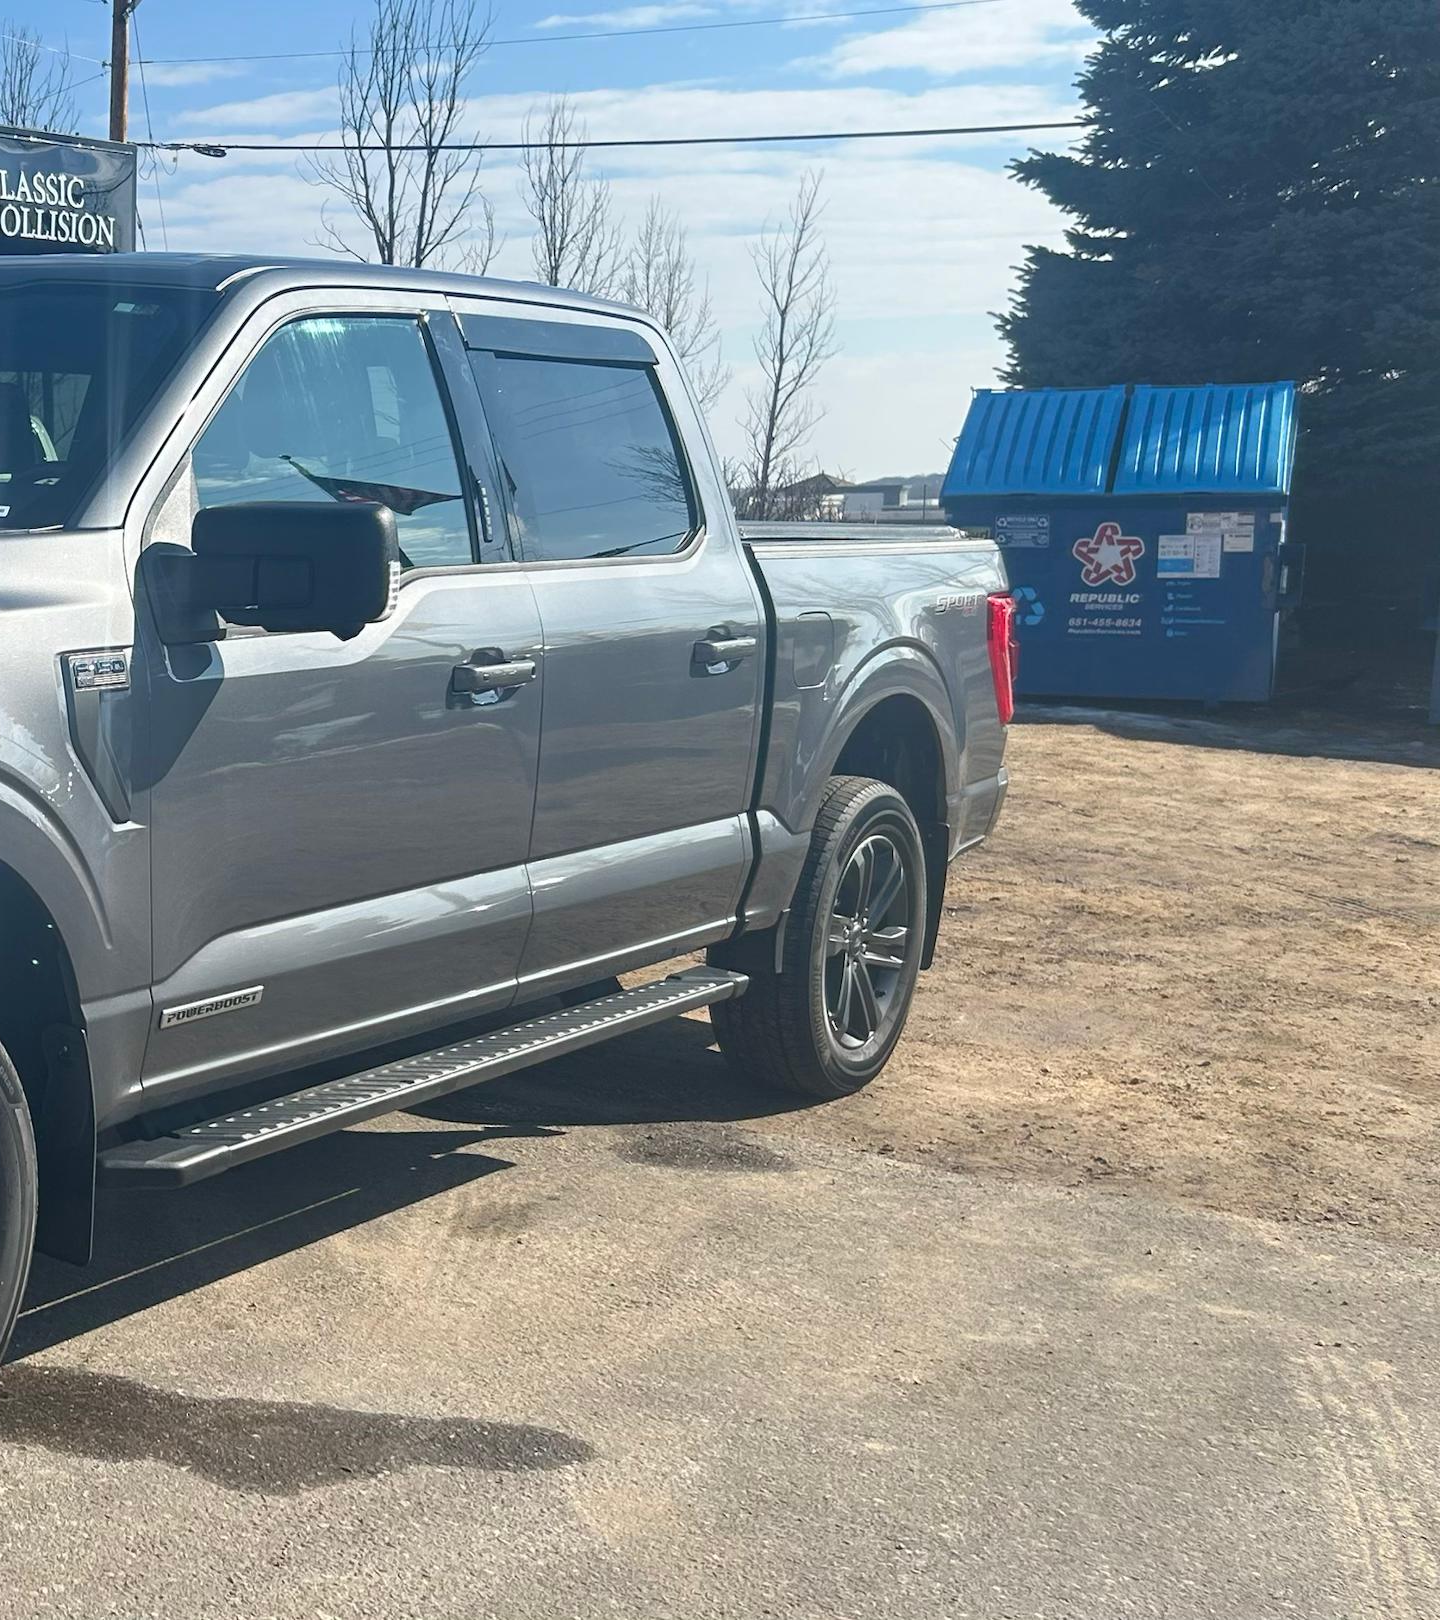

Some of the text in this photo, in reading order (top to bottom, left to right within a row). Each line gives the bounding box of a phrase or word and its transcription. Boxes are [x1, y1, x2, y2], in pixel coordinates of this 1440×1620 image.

[1069, 593, 1141, 604] REPUBLIC
[1084, 603, 1123, 611] SERVICES
[166, 991, 261, 1024] POWERBOOST
